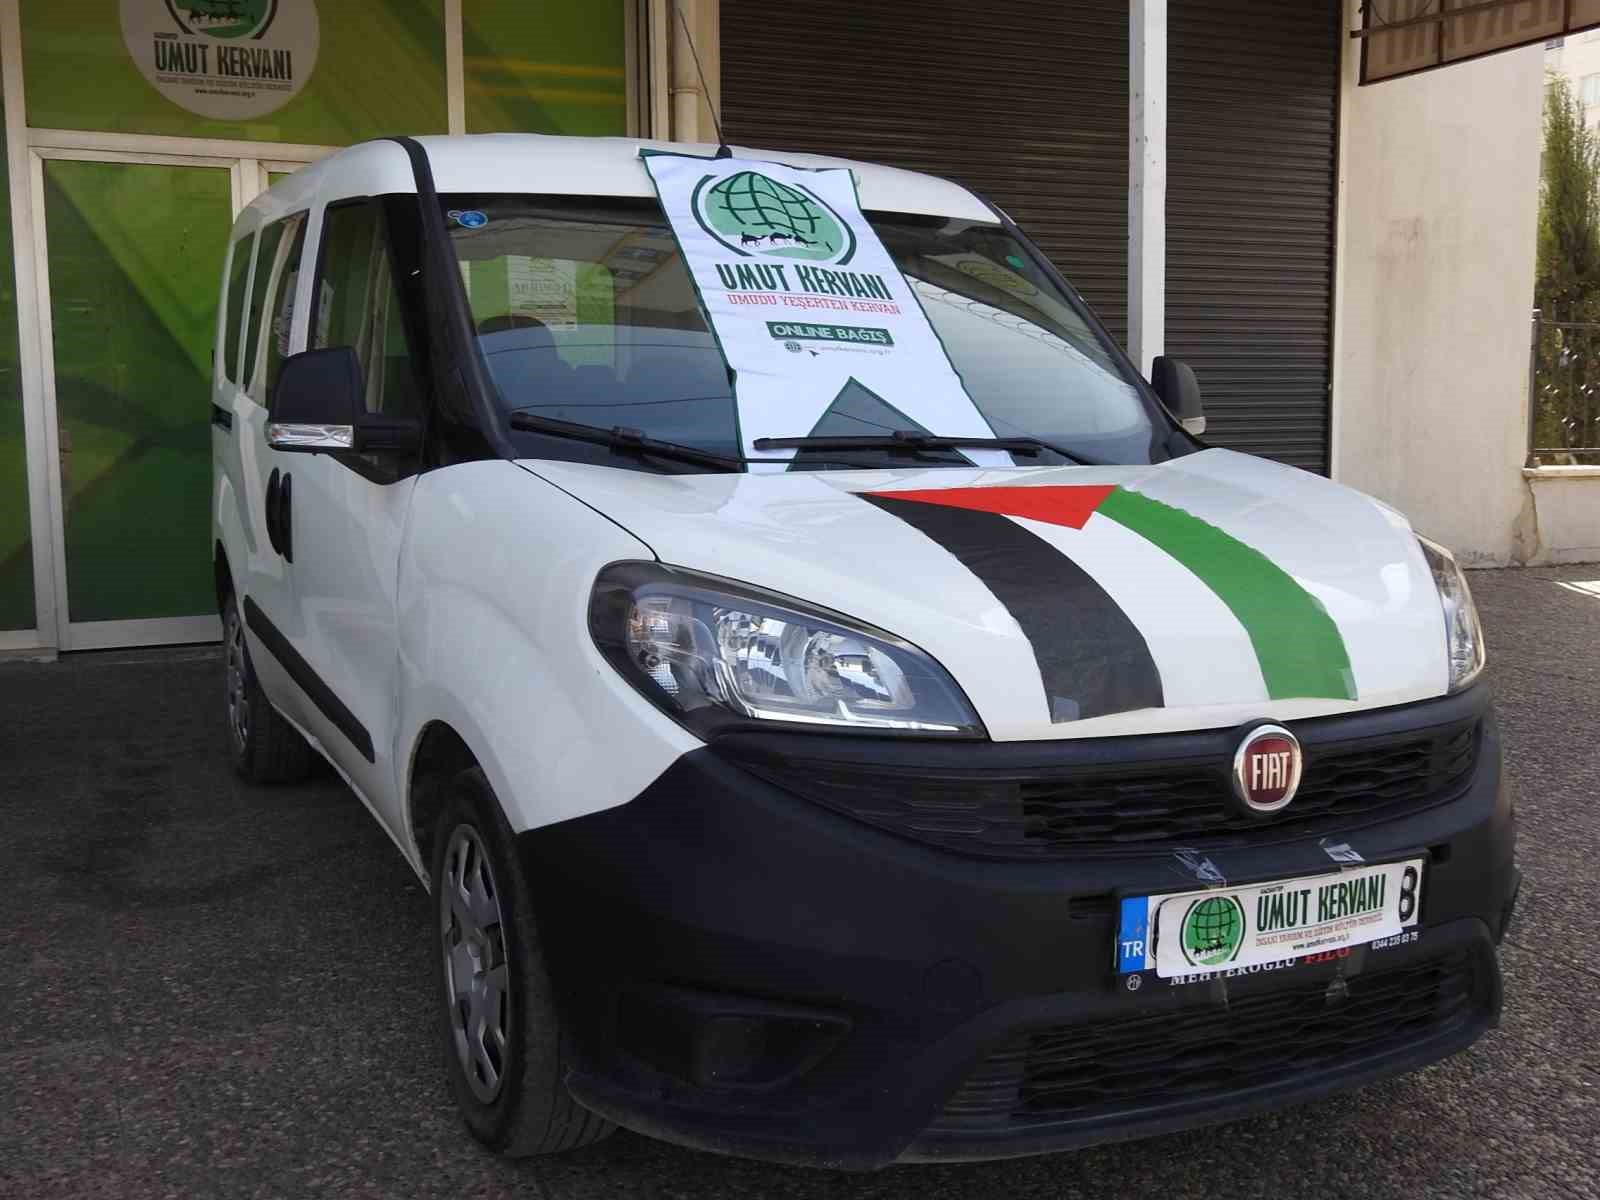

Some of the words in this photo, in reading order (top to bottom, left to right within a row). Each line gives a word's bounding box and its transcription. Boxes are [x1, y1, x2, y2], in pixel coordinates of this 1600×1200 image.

[153, 40, 209, 74] UMUT
[216, 46, 293, 81] KERVANI
[715, 263, 791, 292] UMUT
[793, 264, 894, 301] KERVANI
[728, 293, 778, 306] UMUDU
[782, 295, 849, 312] YEŞERTEN
[850, 300, 902, 316] KERVAN
[773, 324, 834, 339] ONLINE
[836, 328, 888, 344] BAĞIŞ
[1251, 751, 1291, 791] FIAT
[1256, 888, 1312, 932] UMUT
[1317, 873, 1387, 923] KERVANI
[1122, 940, 1144, 959] TR
